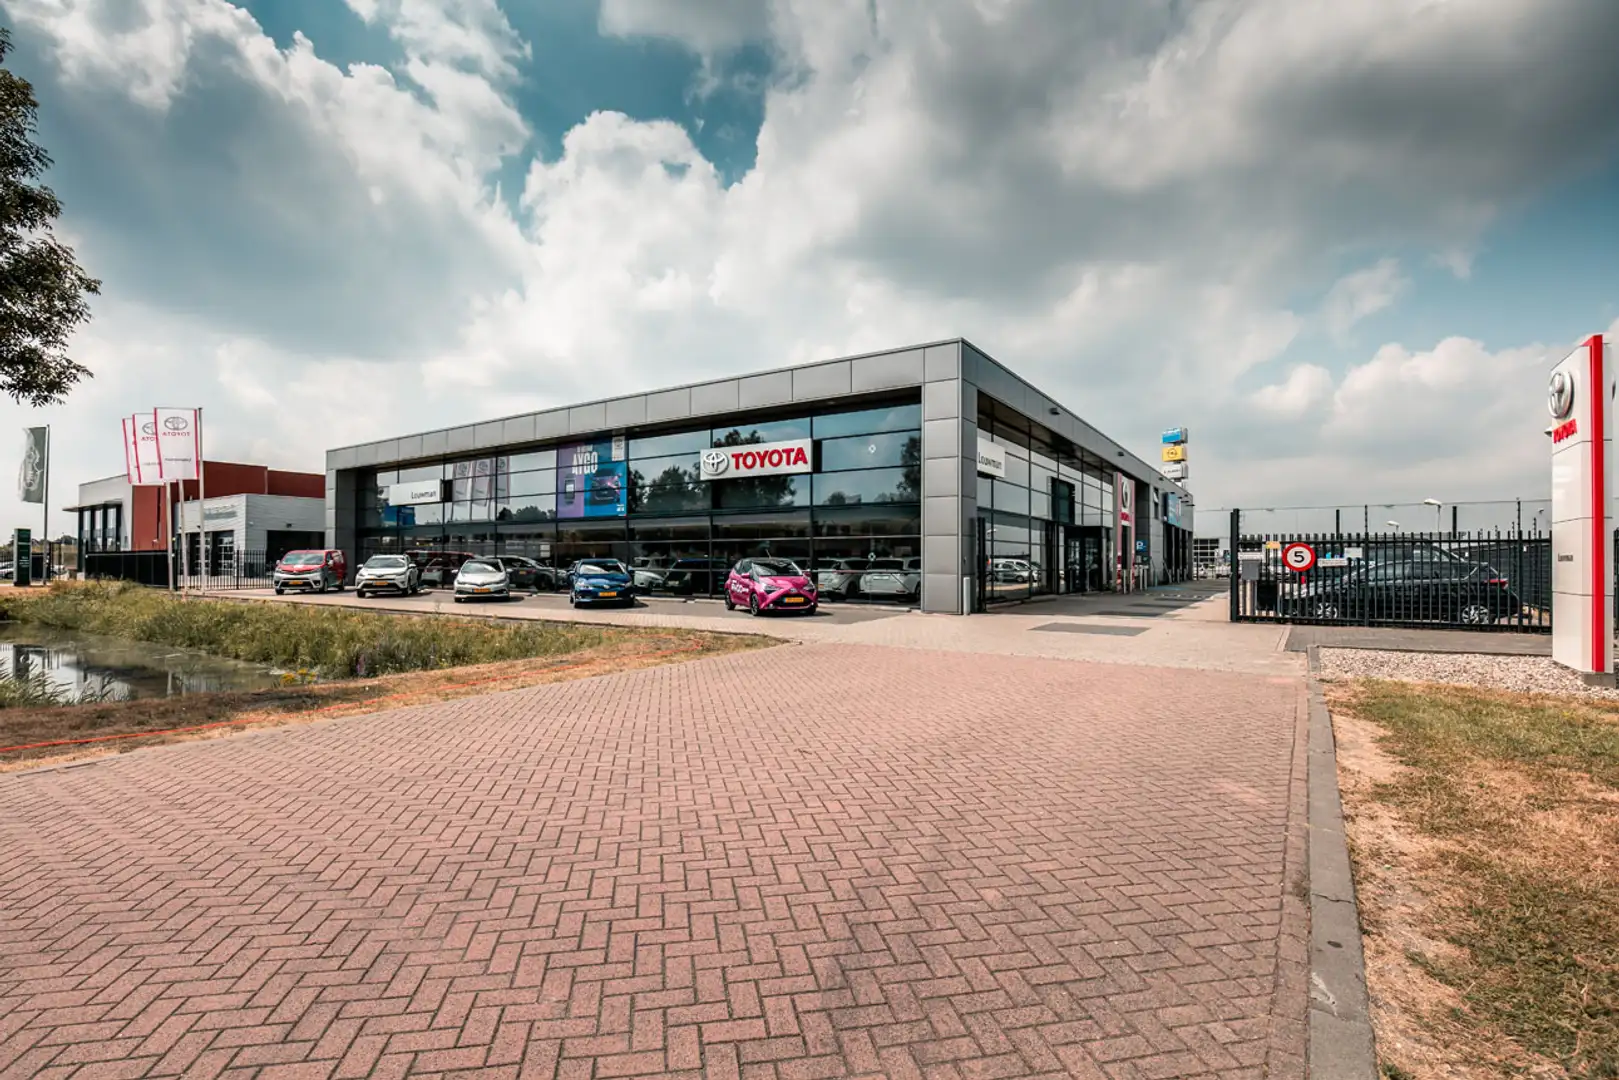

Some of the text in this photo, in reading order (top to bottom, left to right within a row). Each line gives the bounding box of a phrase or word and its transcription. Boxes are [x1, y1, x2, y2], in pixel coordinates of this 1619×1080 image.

[572, 451, 598, 475] AYGO
[731, 447, 808, 470] TOYOTA
[1294, 551, 1305, 563] 5
